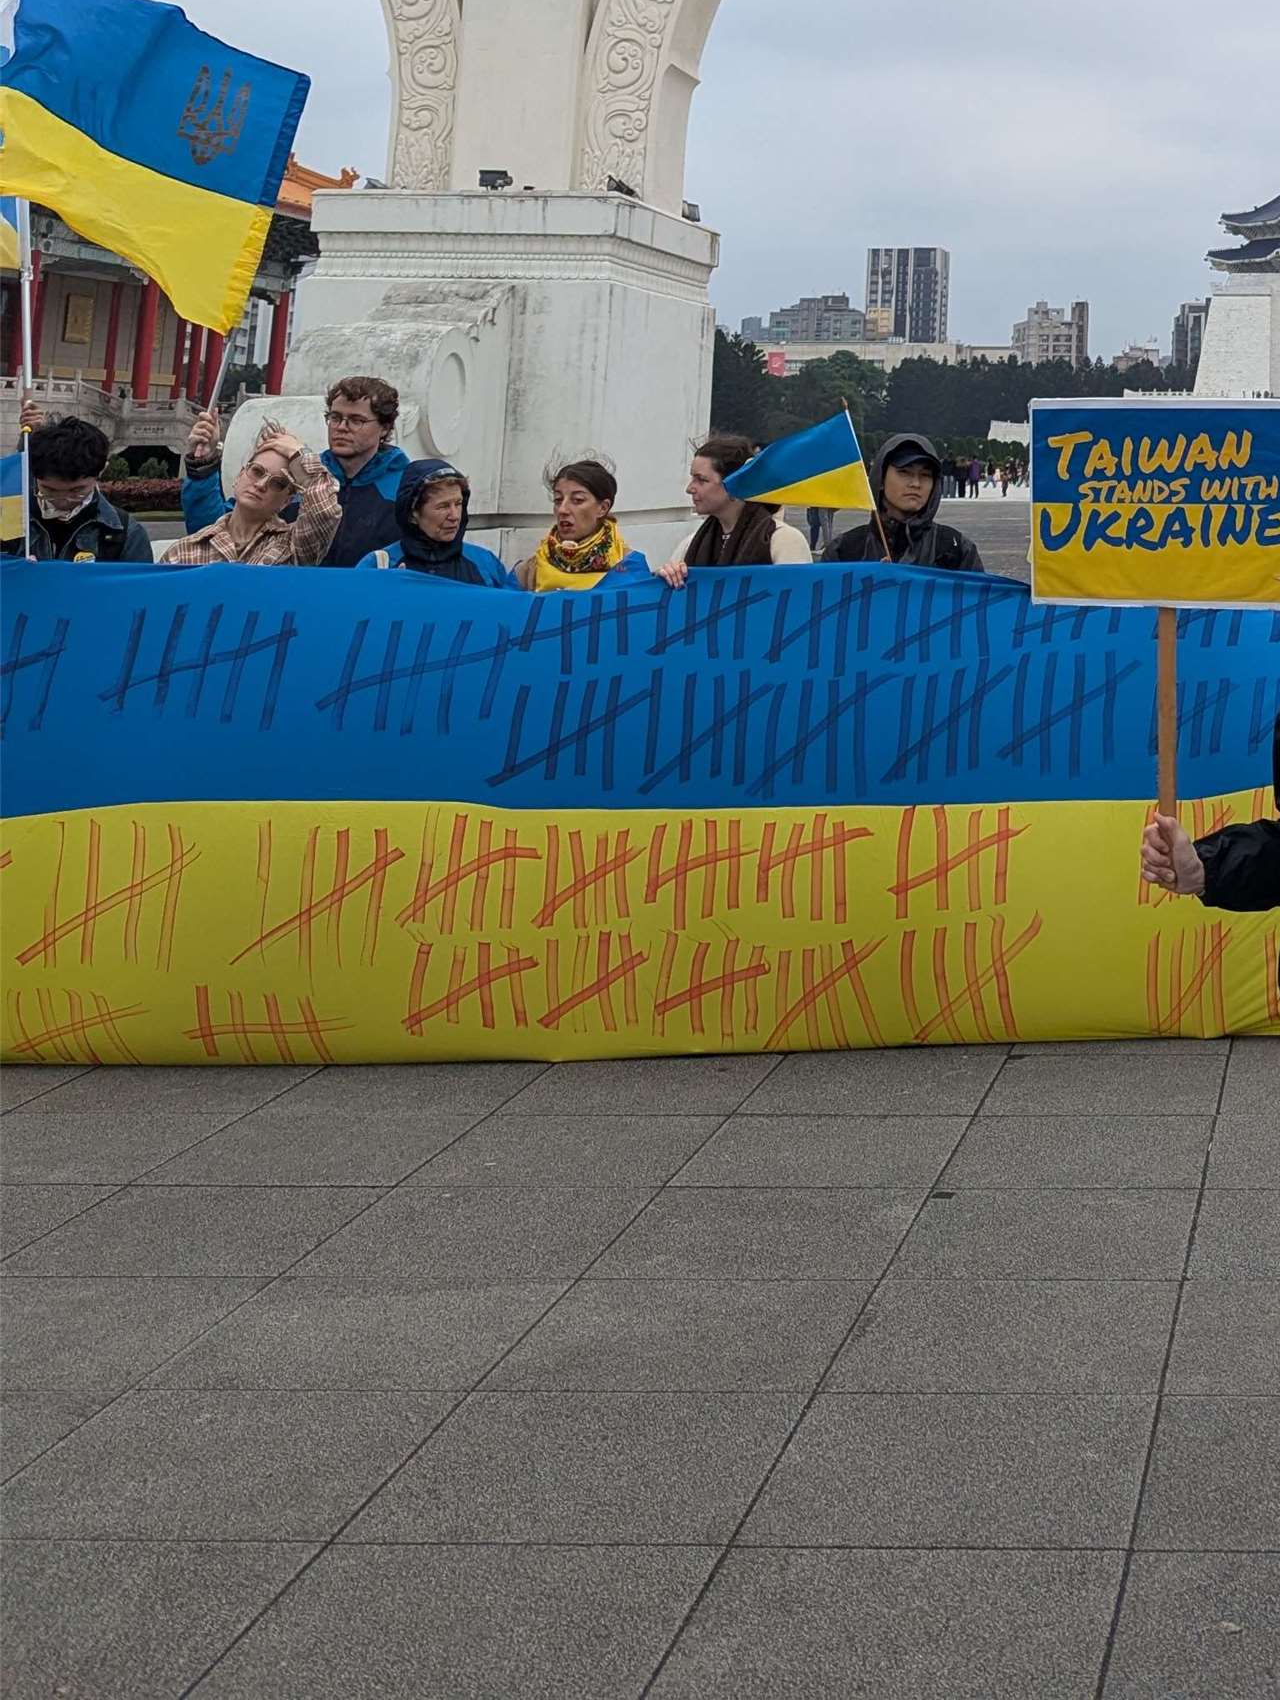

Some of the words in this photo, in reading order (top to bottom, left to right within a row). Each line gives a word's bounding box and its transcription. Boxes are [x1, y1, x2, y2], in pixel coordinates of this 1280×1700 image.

[1047, 429, 1253, 481] TAIWAN
[1077, 476, 1192, 504] STANDS
[1200, 474, 1280, 501] WITH
